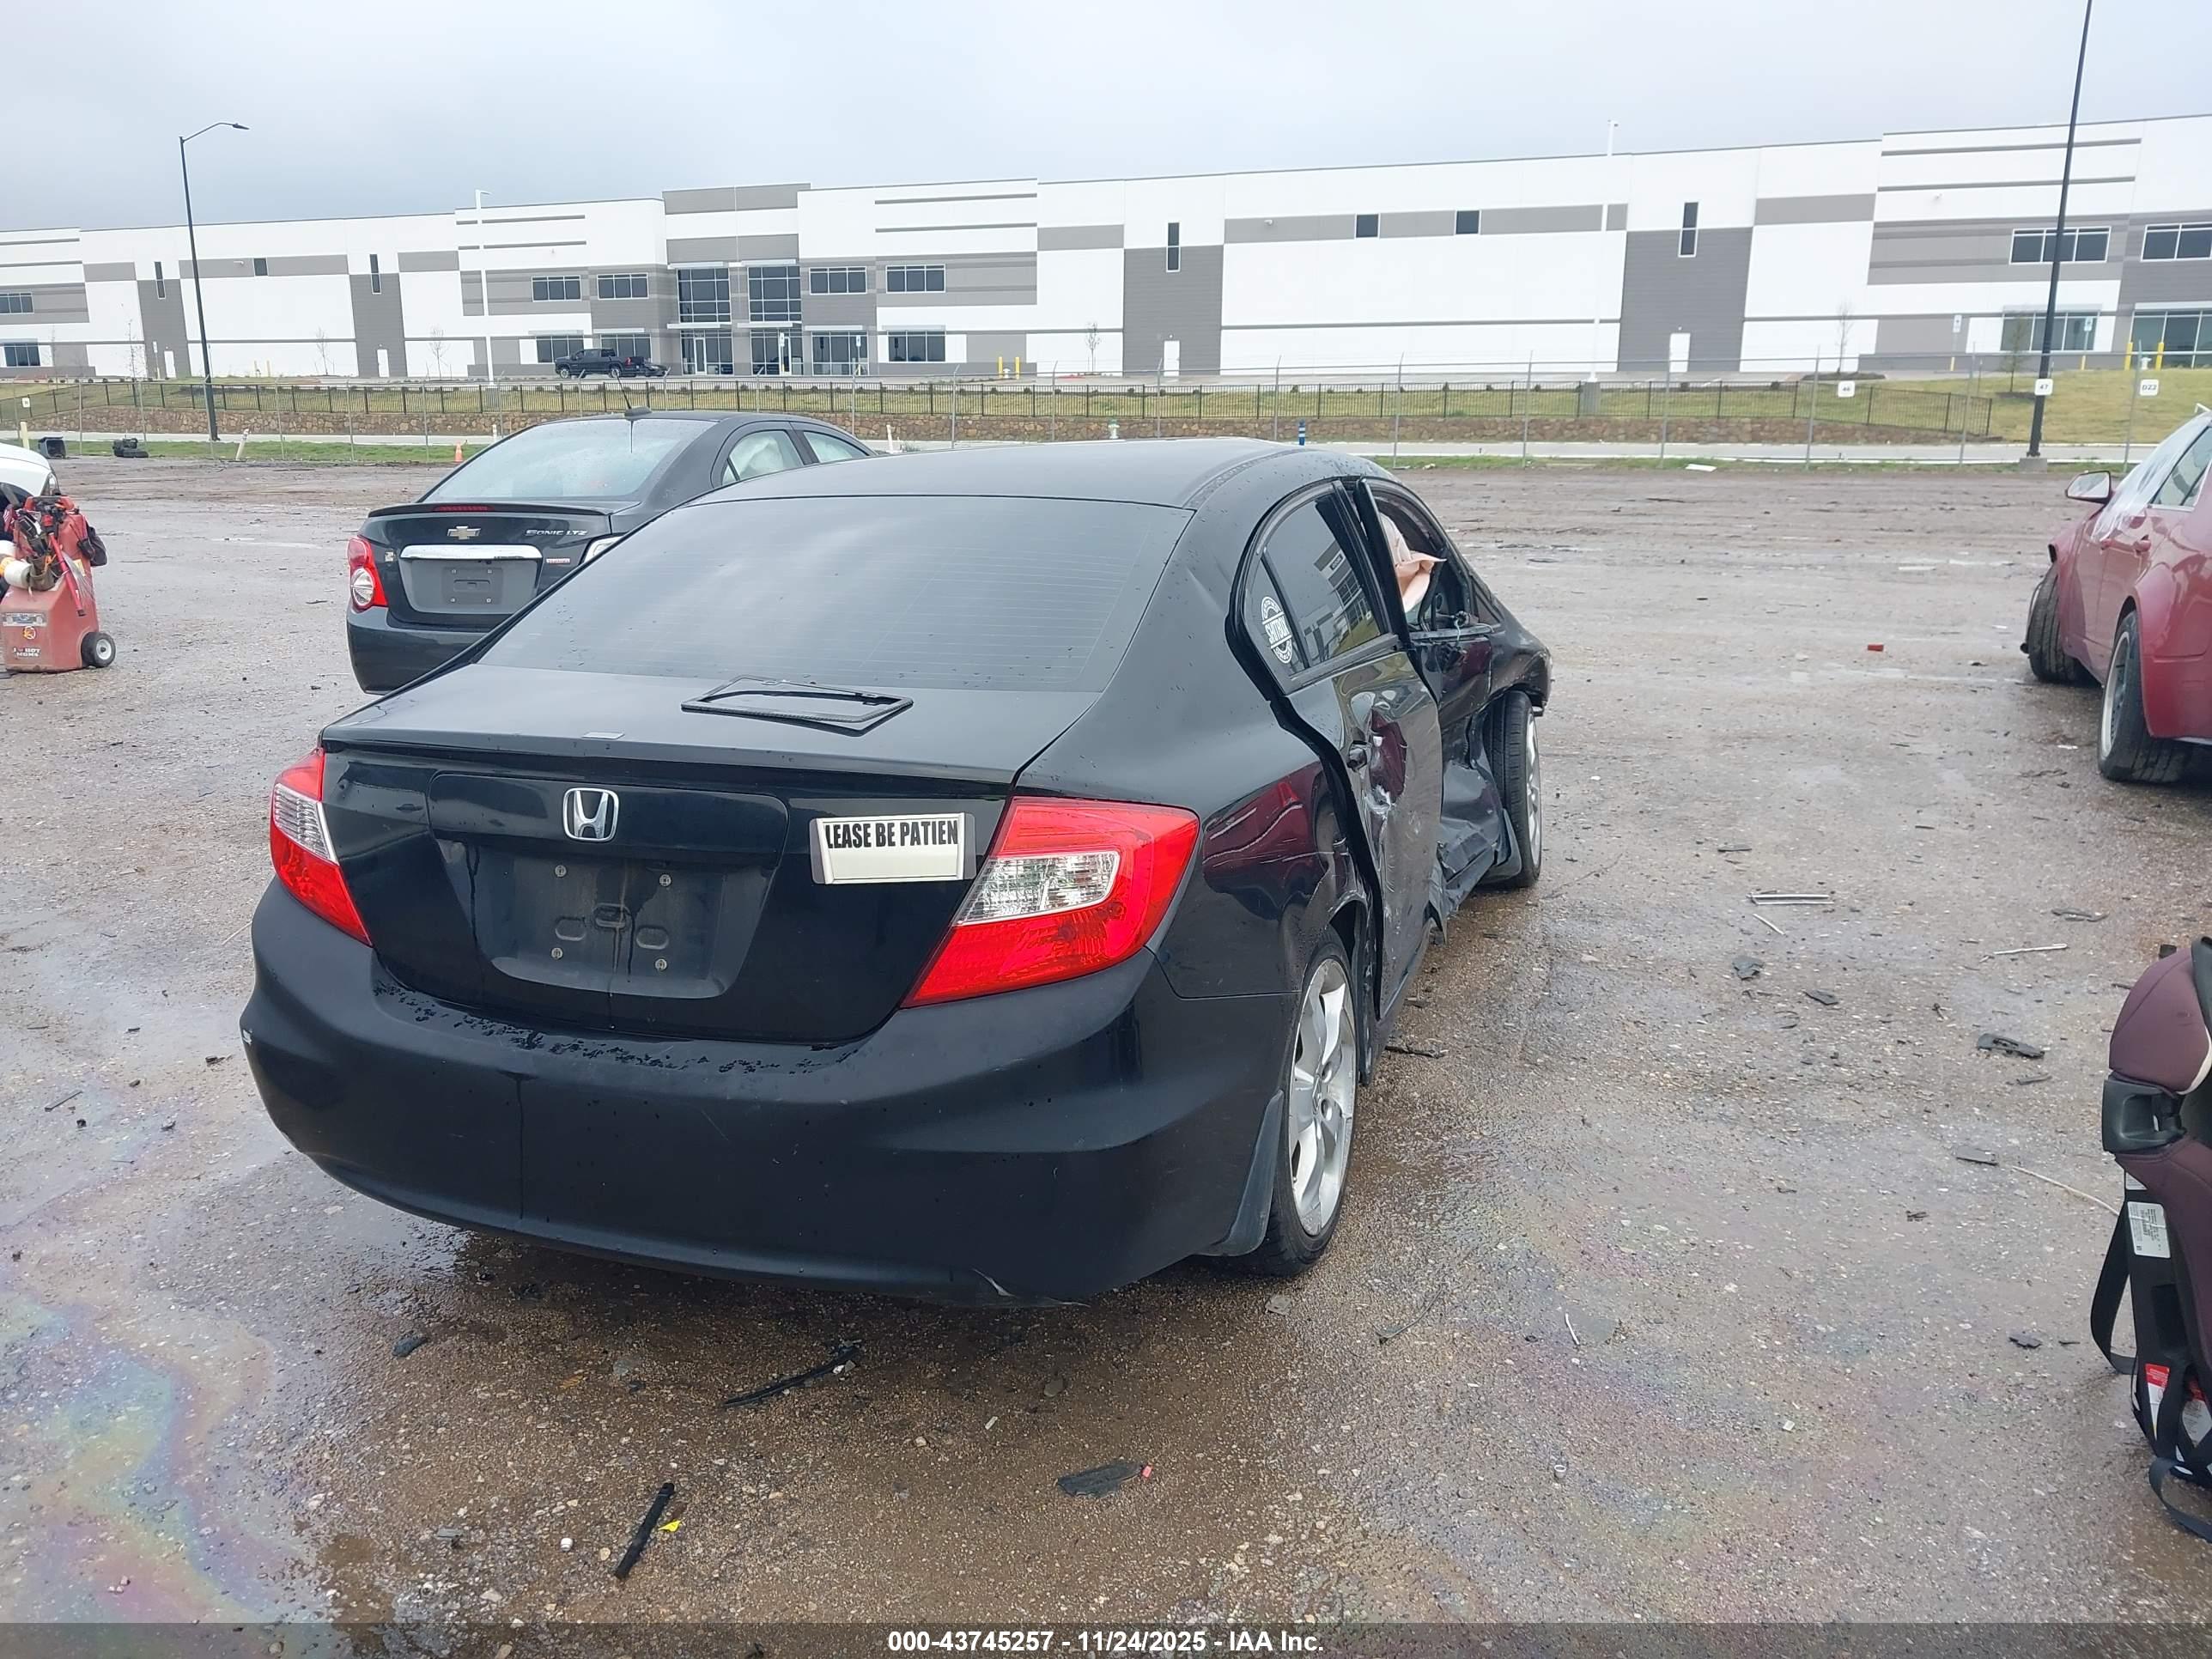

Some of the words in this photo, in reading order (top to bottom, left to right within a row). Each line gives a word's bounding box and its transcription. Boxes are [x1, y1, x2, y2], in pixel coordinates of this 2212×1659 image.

[824, 823, 872, 848] LEASE
[875, 822, 896, 848] BE
[900, 820, 958, 847] PATIEN
